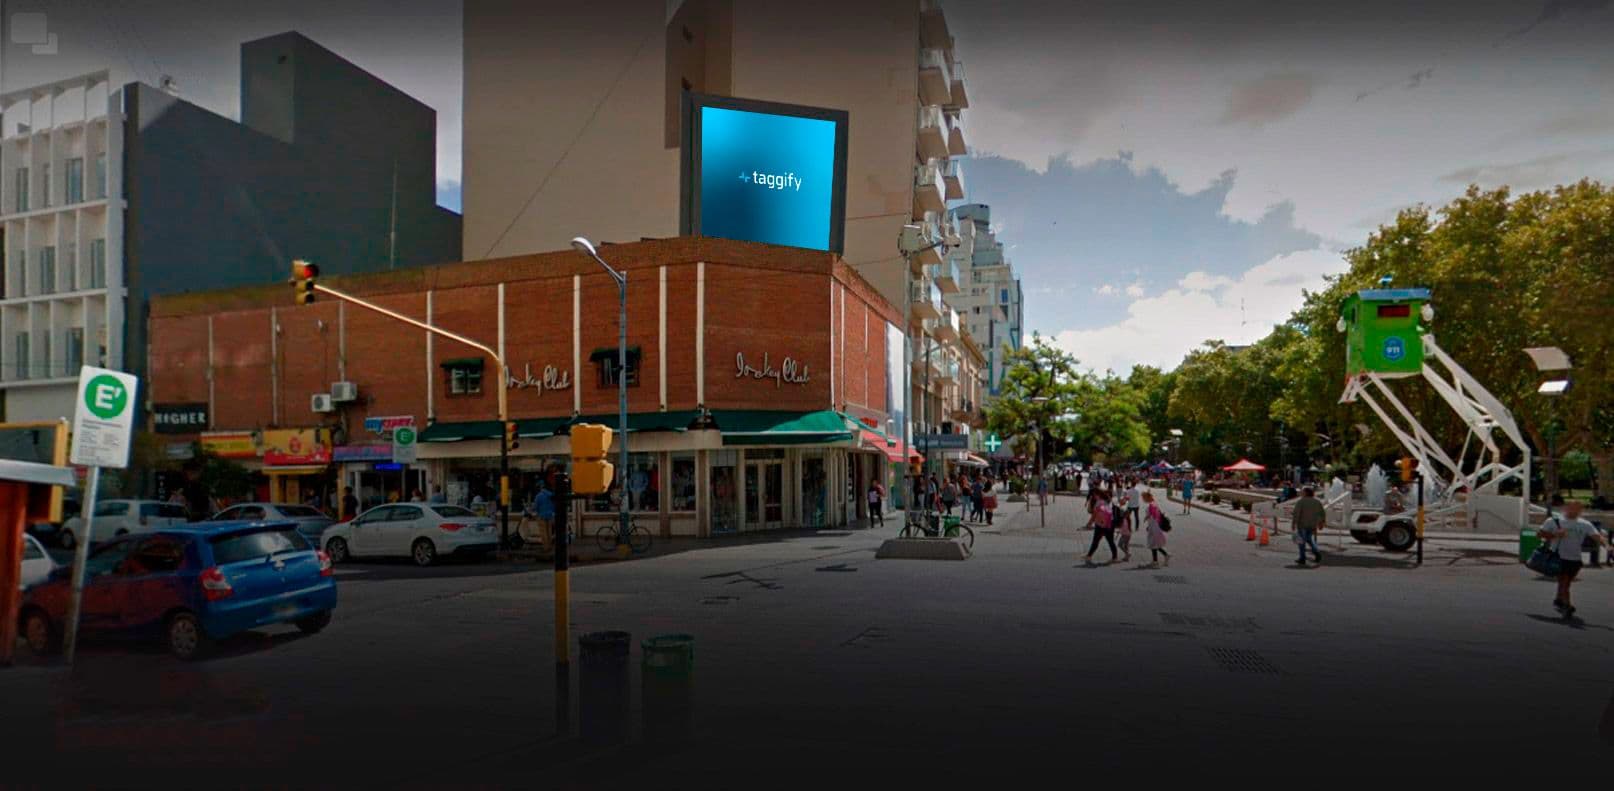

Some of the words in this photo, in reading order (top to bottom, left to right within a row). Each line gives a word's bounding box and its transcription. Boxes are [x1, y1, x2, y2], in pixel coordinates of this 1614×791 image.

[753, 170, 801, 191] taggify
[543, 364, 571, 390] Club
[782, 356, 810, 383] Club
[154, 412, 206, 425] HIGHER
